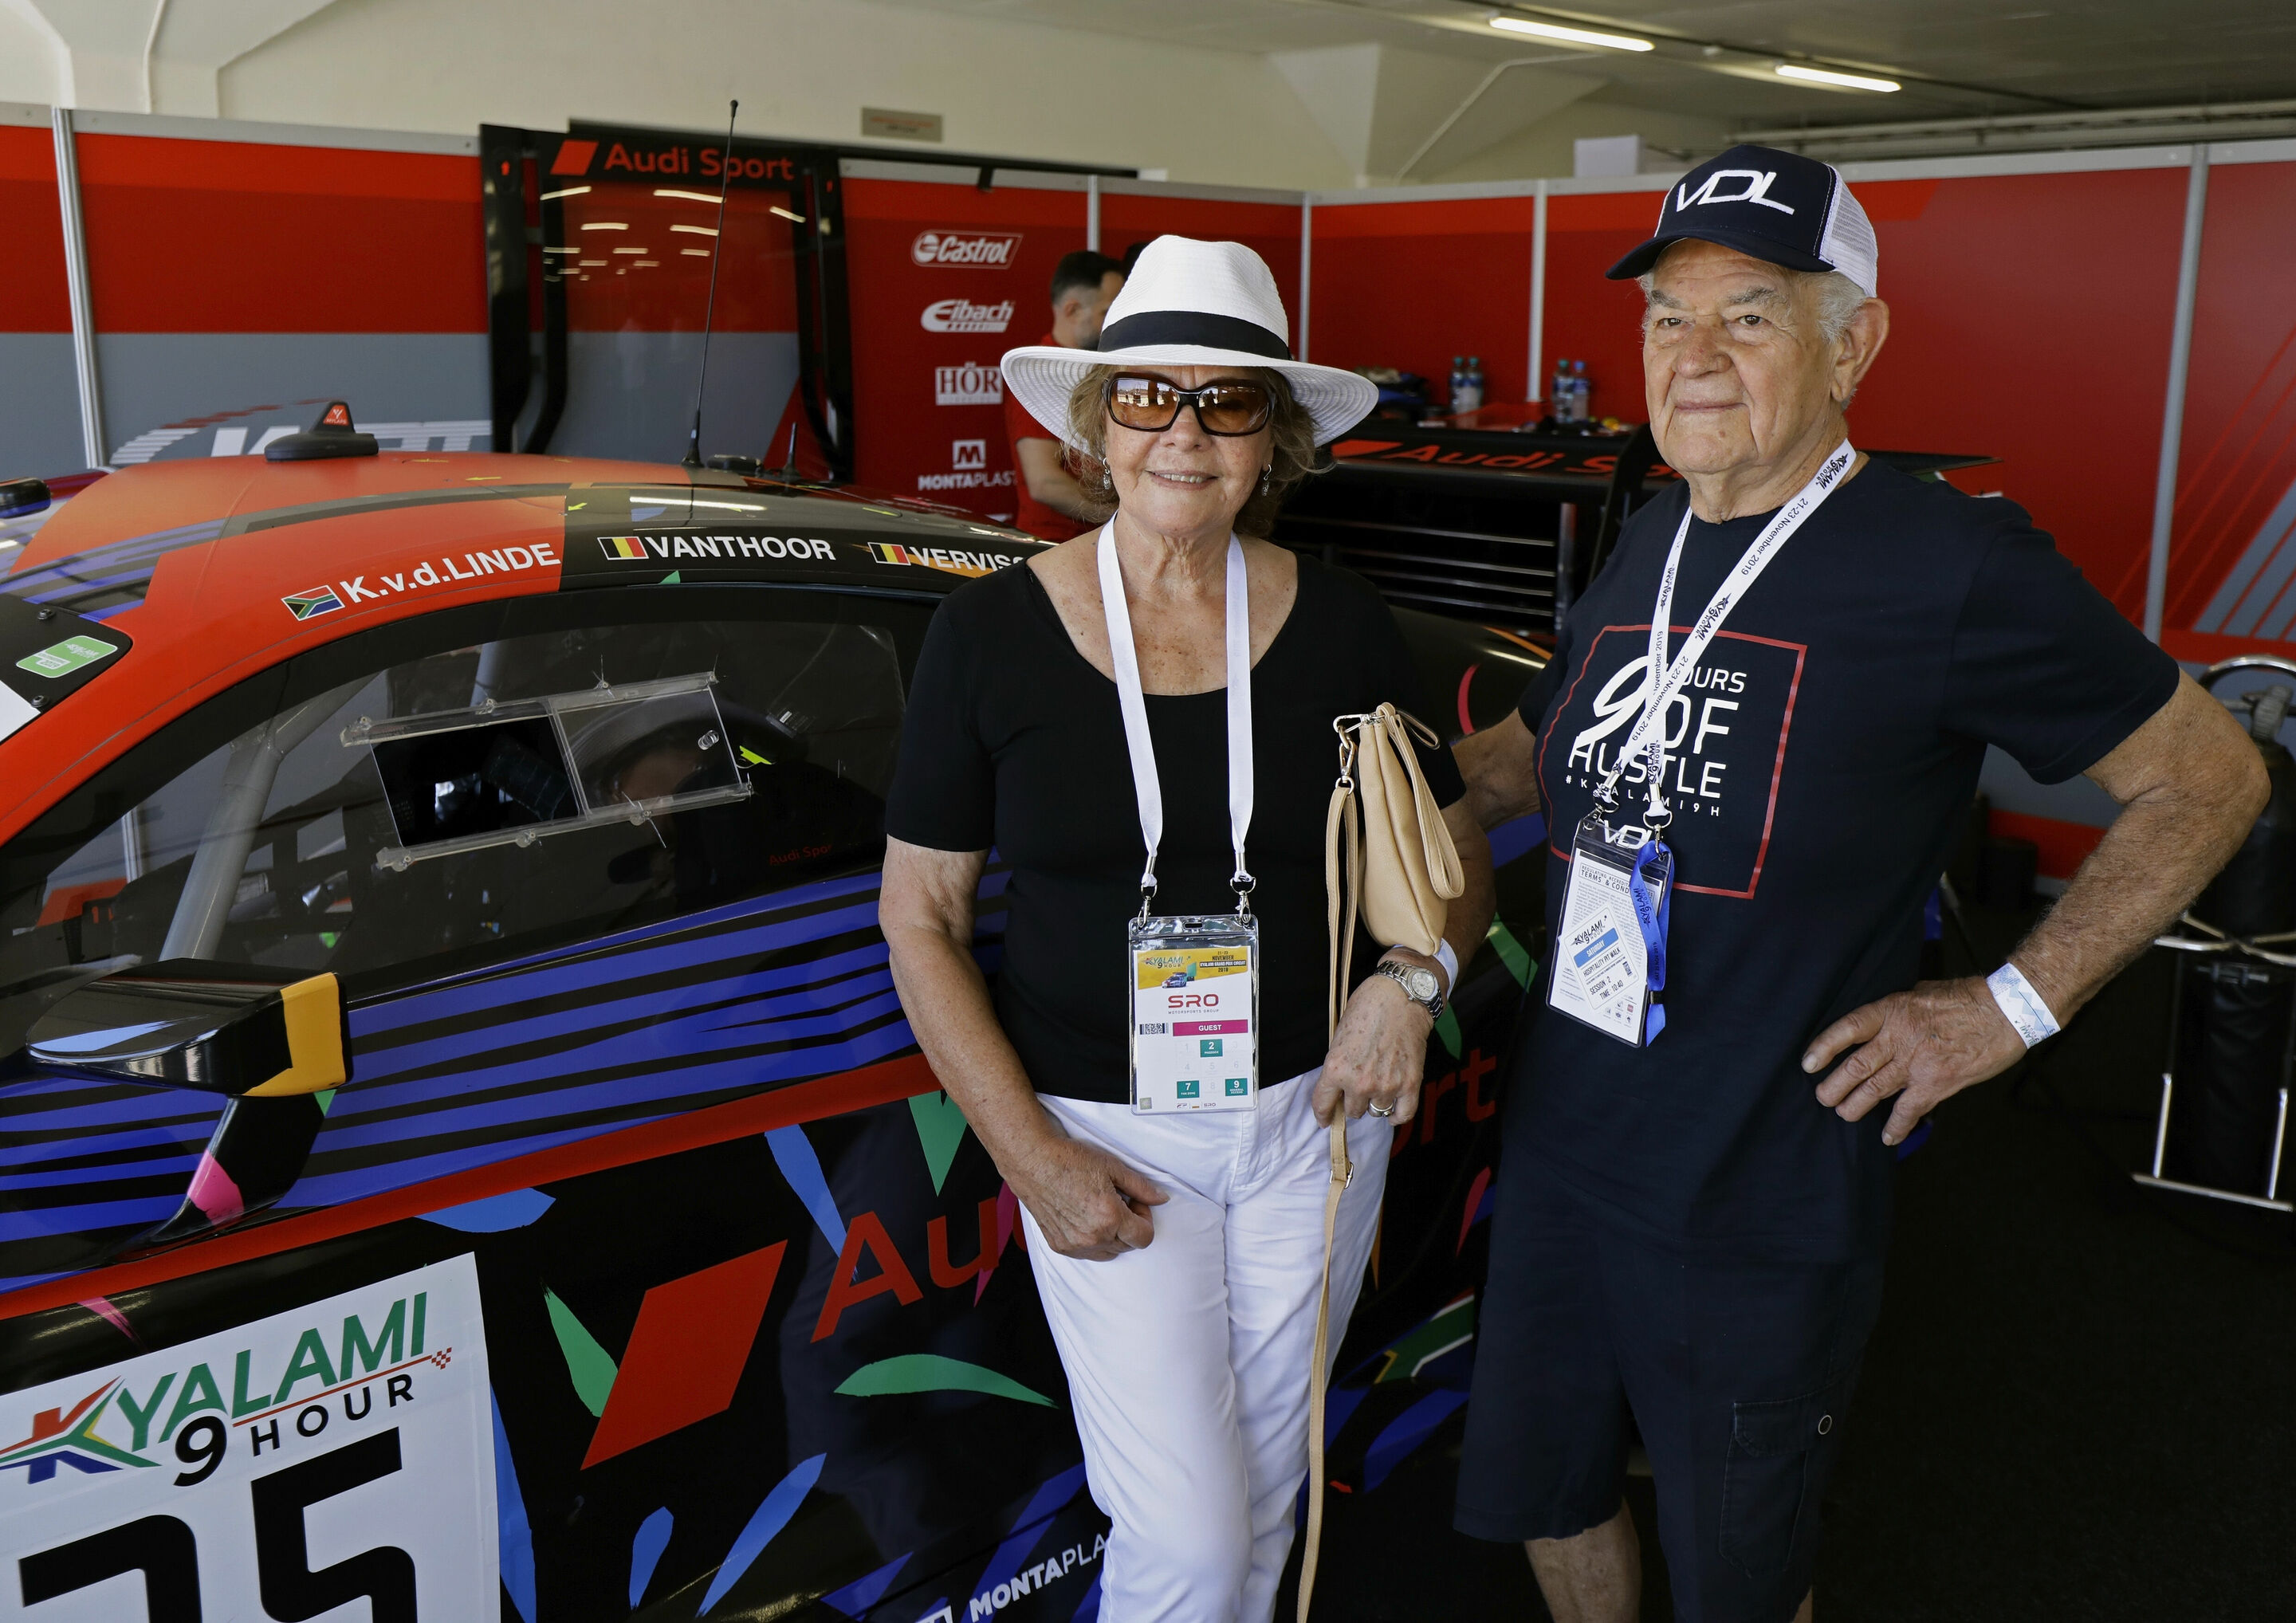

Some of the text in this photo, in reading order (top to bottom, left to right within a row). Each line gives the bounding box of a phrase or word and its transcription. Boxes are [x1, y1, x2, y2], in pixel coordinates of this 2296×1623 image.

[603, 142, 795, 183] Audi Sport
[1677, 170, 1795, 215] VDL
[936, 234, 1013, 264] Castrol
[921, 299, 1014, 332] Eibach
[1382, 444, 1566, 470] Audi
[645, 536, 836, 561] VANTHOOR
[1741, 497, 1809, 576] 21-23 November 2019
[340, 543, 561, 603] K.v.d.LINDE
[1701, 593, 1732, 641] KYALAMI
[1708, 607, 1715, 615] 9
[1632, 655, 1689, 741] 21-23 November 2019
[1581, 870, 1602, 883] TERMS
[1634, 888, 1650, 925] KYALAMI
[1571, 920, 1603, 945] KYALAMI
[1585, 936, 1590, 945] 9
[1144, 957, 1183, 965] KYALAMI
[1583, 959, 1604, 977] HOSPITALITY
[1610, 947, 1621, 958] WALK
[1168, 993, 1219, 1008] SRO
[1590, 980, 1606, 996] SESSION
[1599, 988, 1610, 1000] TIME
[1208, 1041, 1215, 1050] 2
[810, 1197, 1028, 1344] Au
[0, 1291, 427, 1484] KYALAMI
[173, 1373, 415, 1487] 9 HOUR
